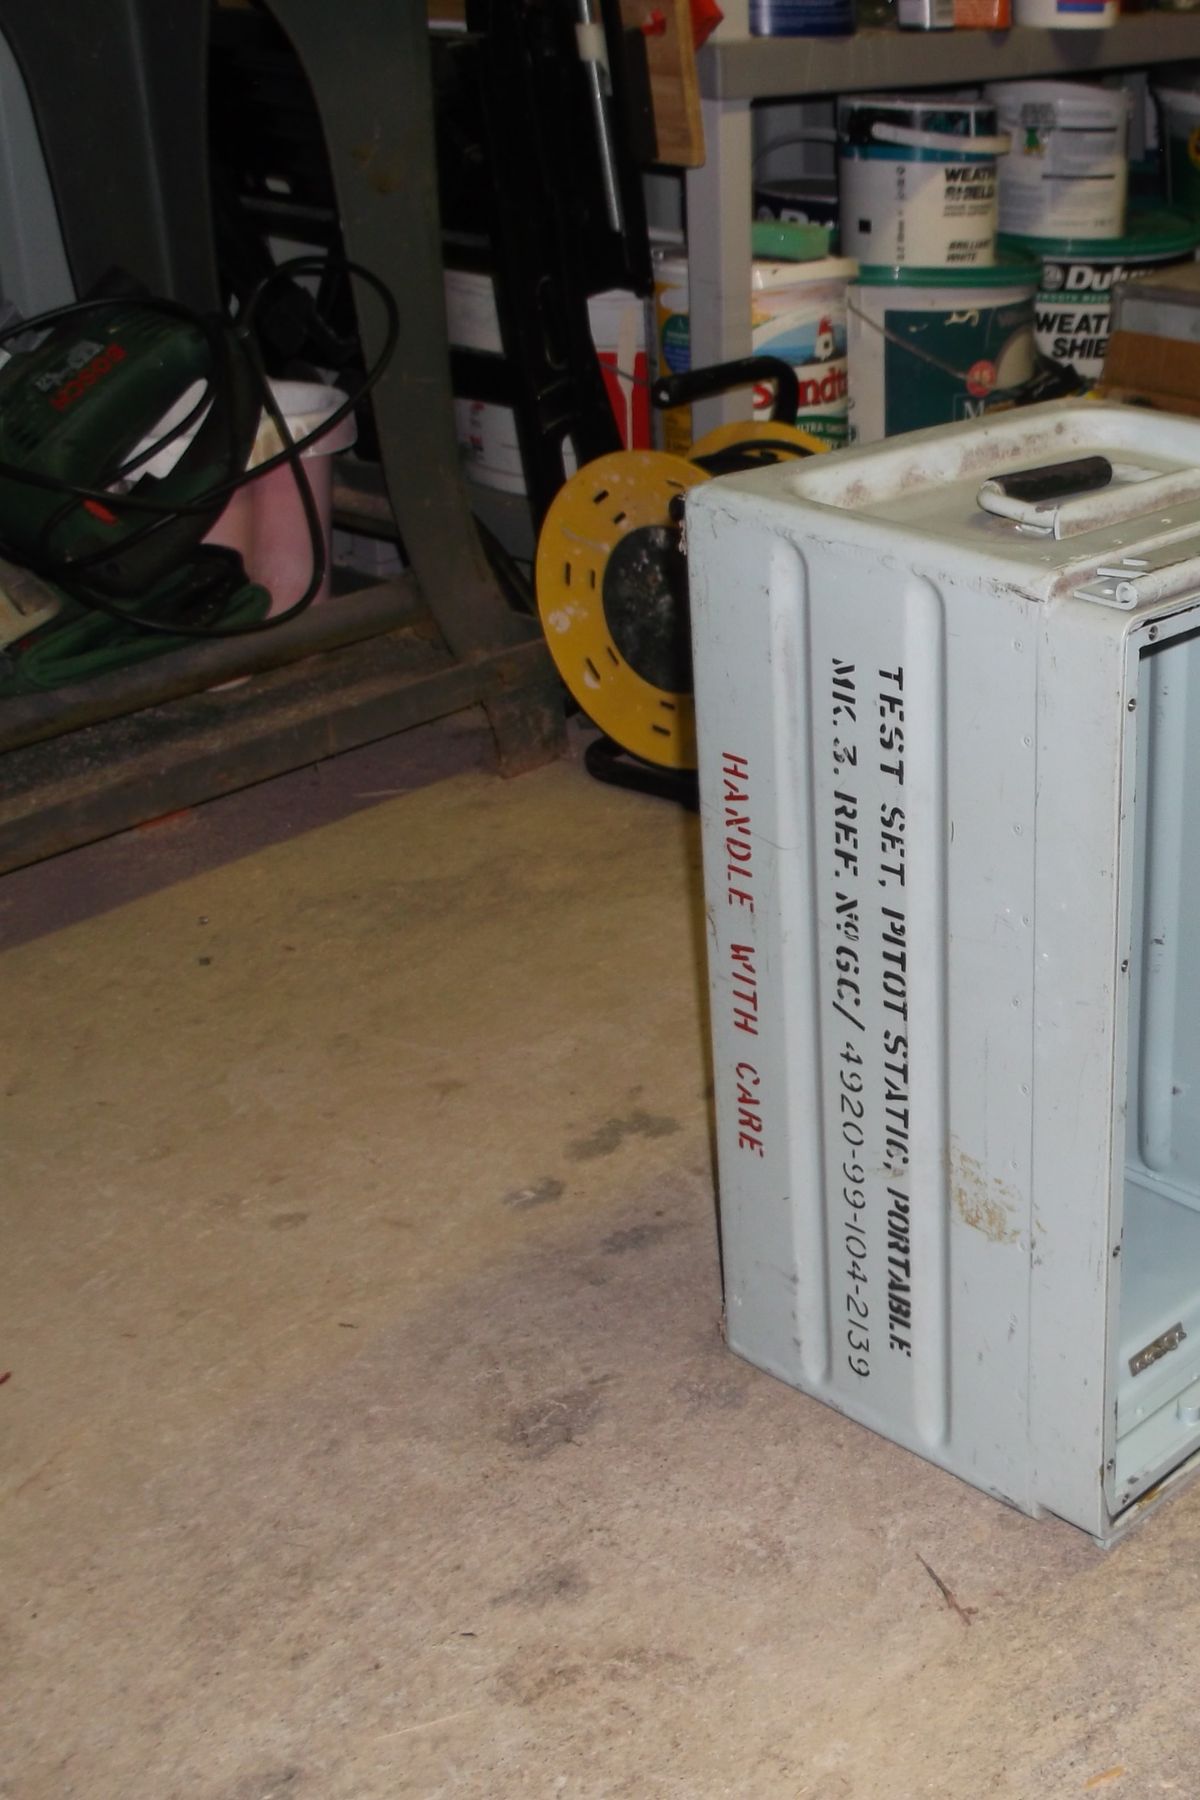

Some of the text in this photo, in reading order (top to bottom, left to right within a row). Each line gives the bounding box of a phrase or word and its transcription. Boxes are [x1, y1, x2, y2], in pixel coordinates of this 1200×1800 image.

[832, 658, 856, 726] MK.
[832, 737, 857, 775] 3.
[833, 790, 859, 878] REF.
[722, 752, 764, 1158] HANDLE WITH CARE
[878, 666, 911, 1358] TEST SET, PITOT STATIC, PORTABLE
